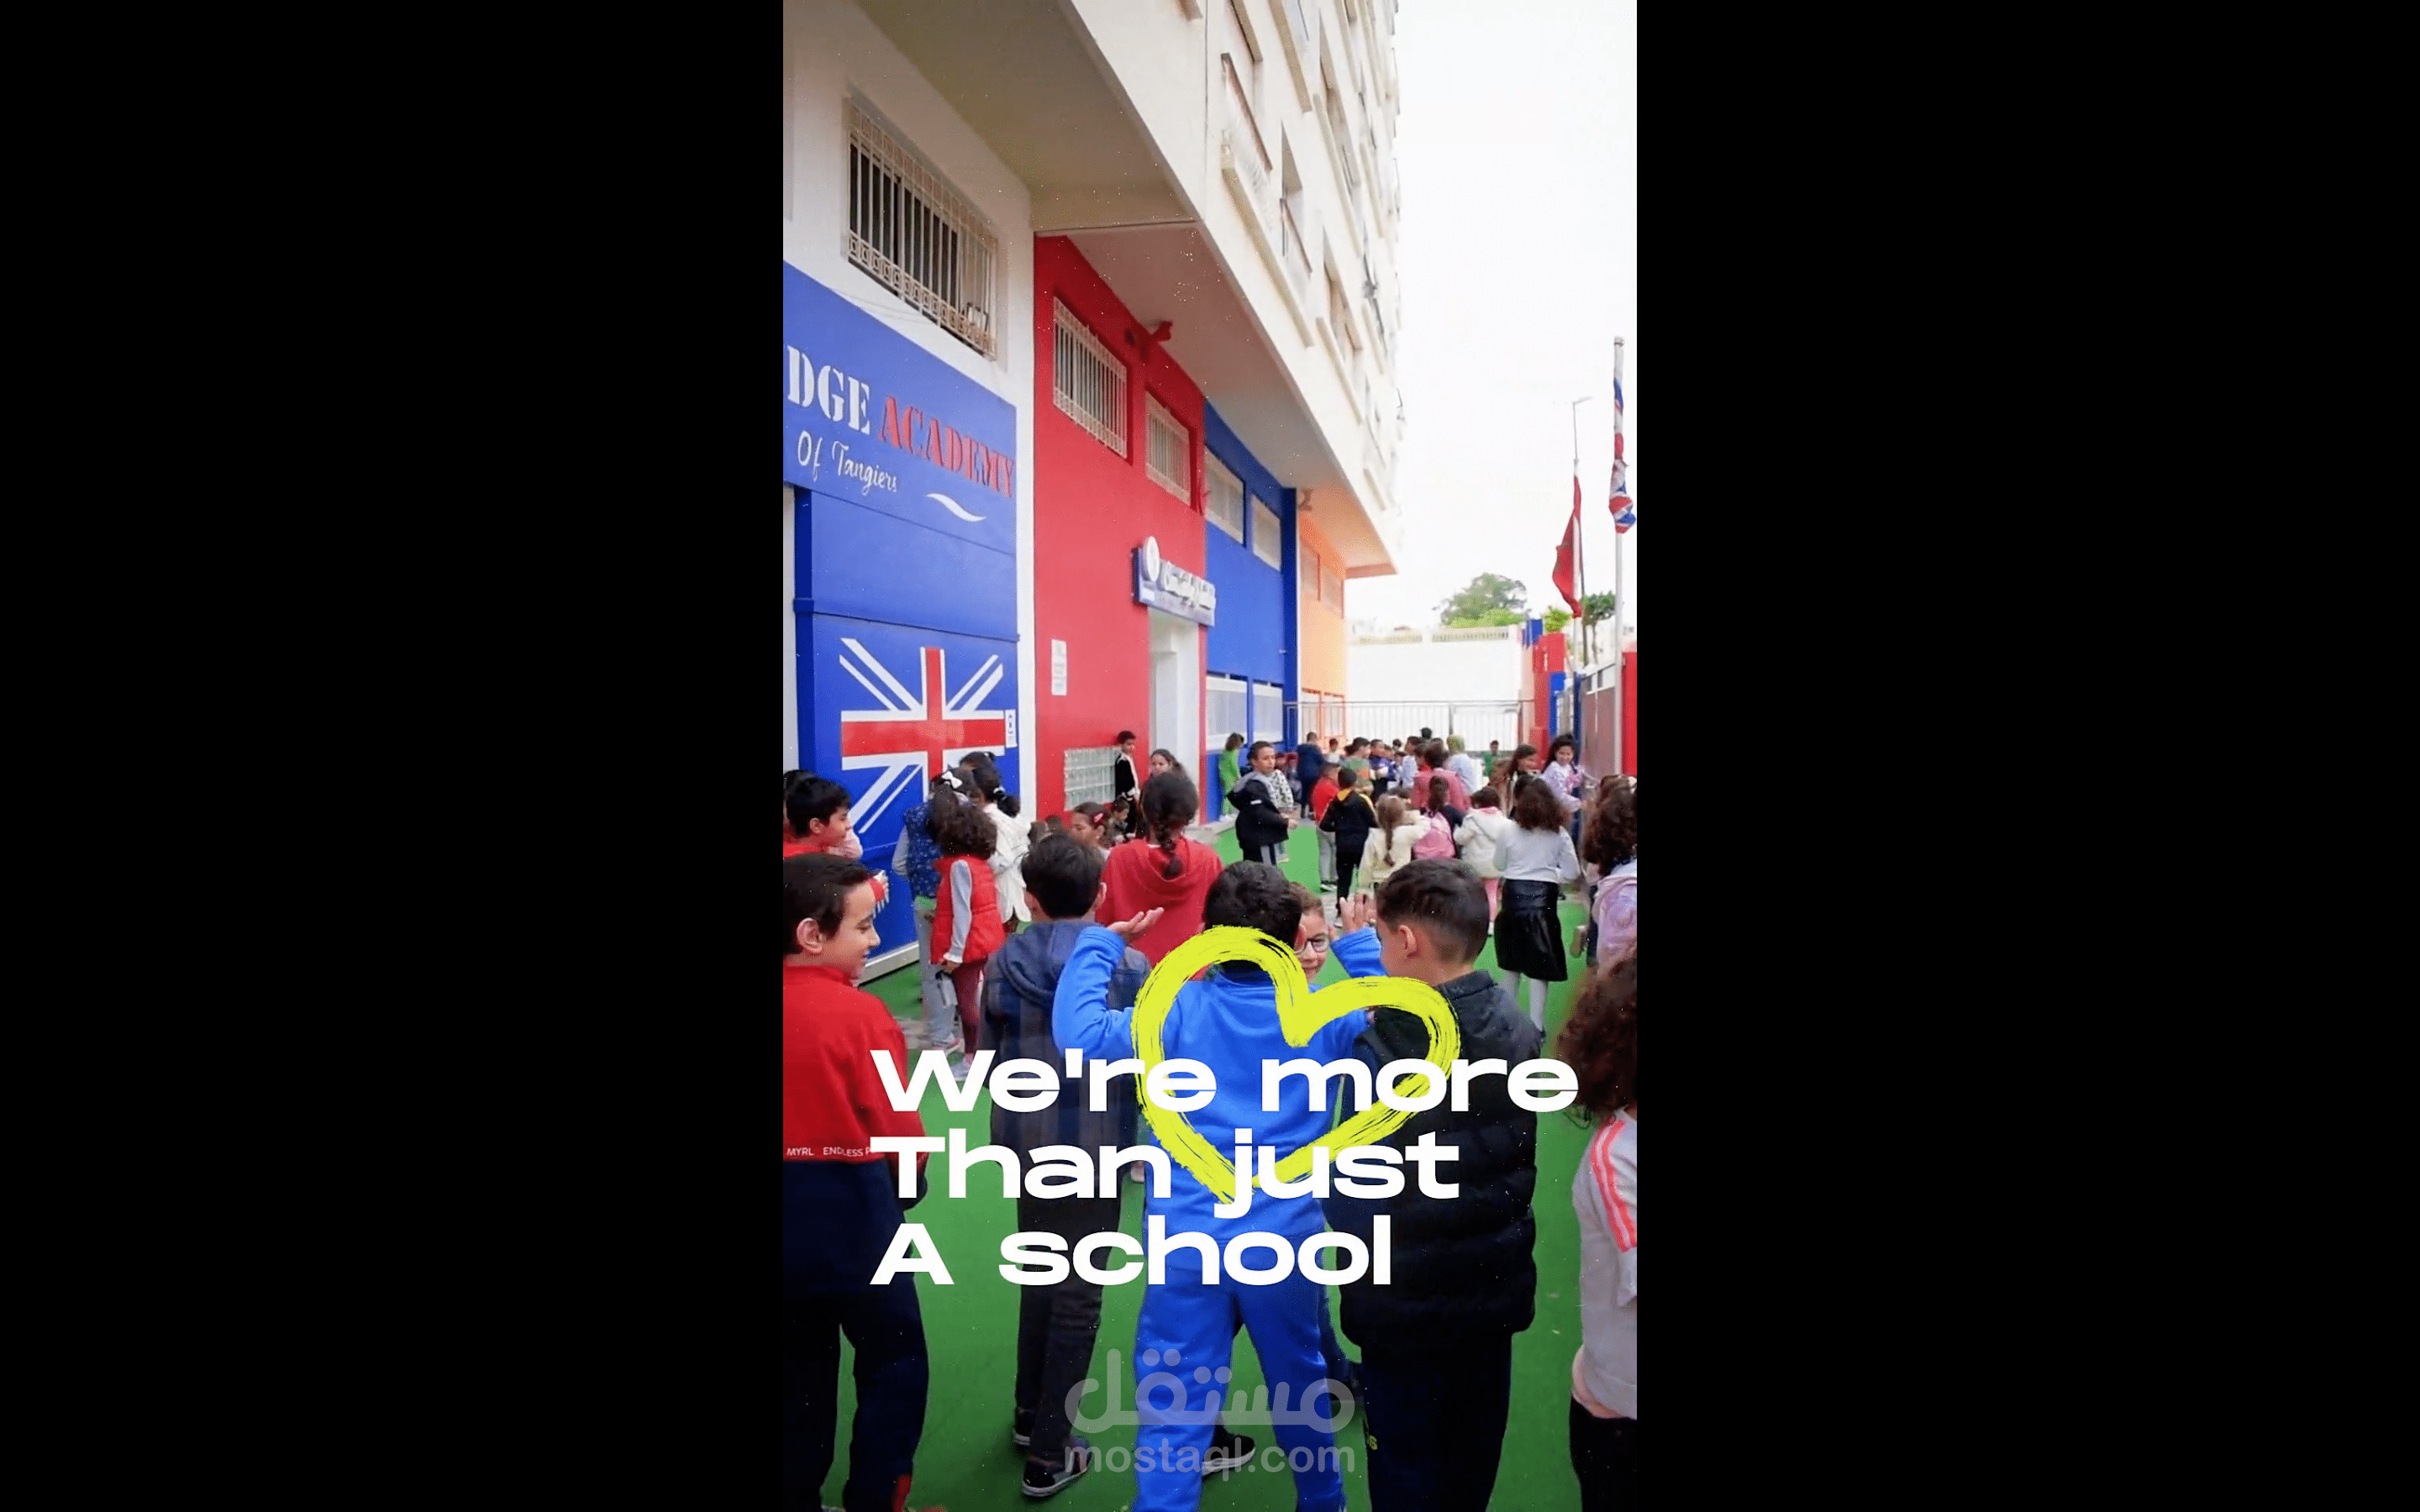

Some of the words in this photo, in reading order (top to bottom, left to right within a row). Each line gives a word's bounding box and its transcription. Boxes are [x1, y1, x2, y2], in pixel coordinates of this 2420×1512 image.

[786, 344, 870, 435] DGE
[878, 394, 1016, 497] ACADEMY
[797, 430, 823, 482] Of
[831, 440, 897, 496] Tangiers
[823, 1146, 864, 1158] ENDLESS
